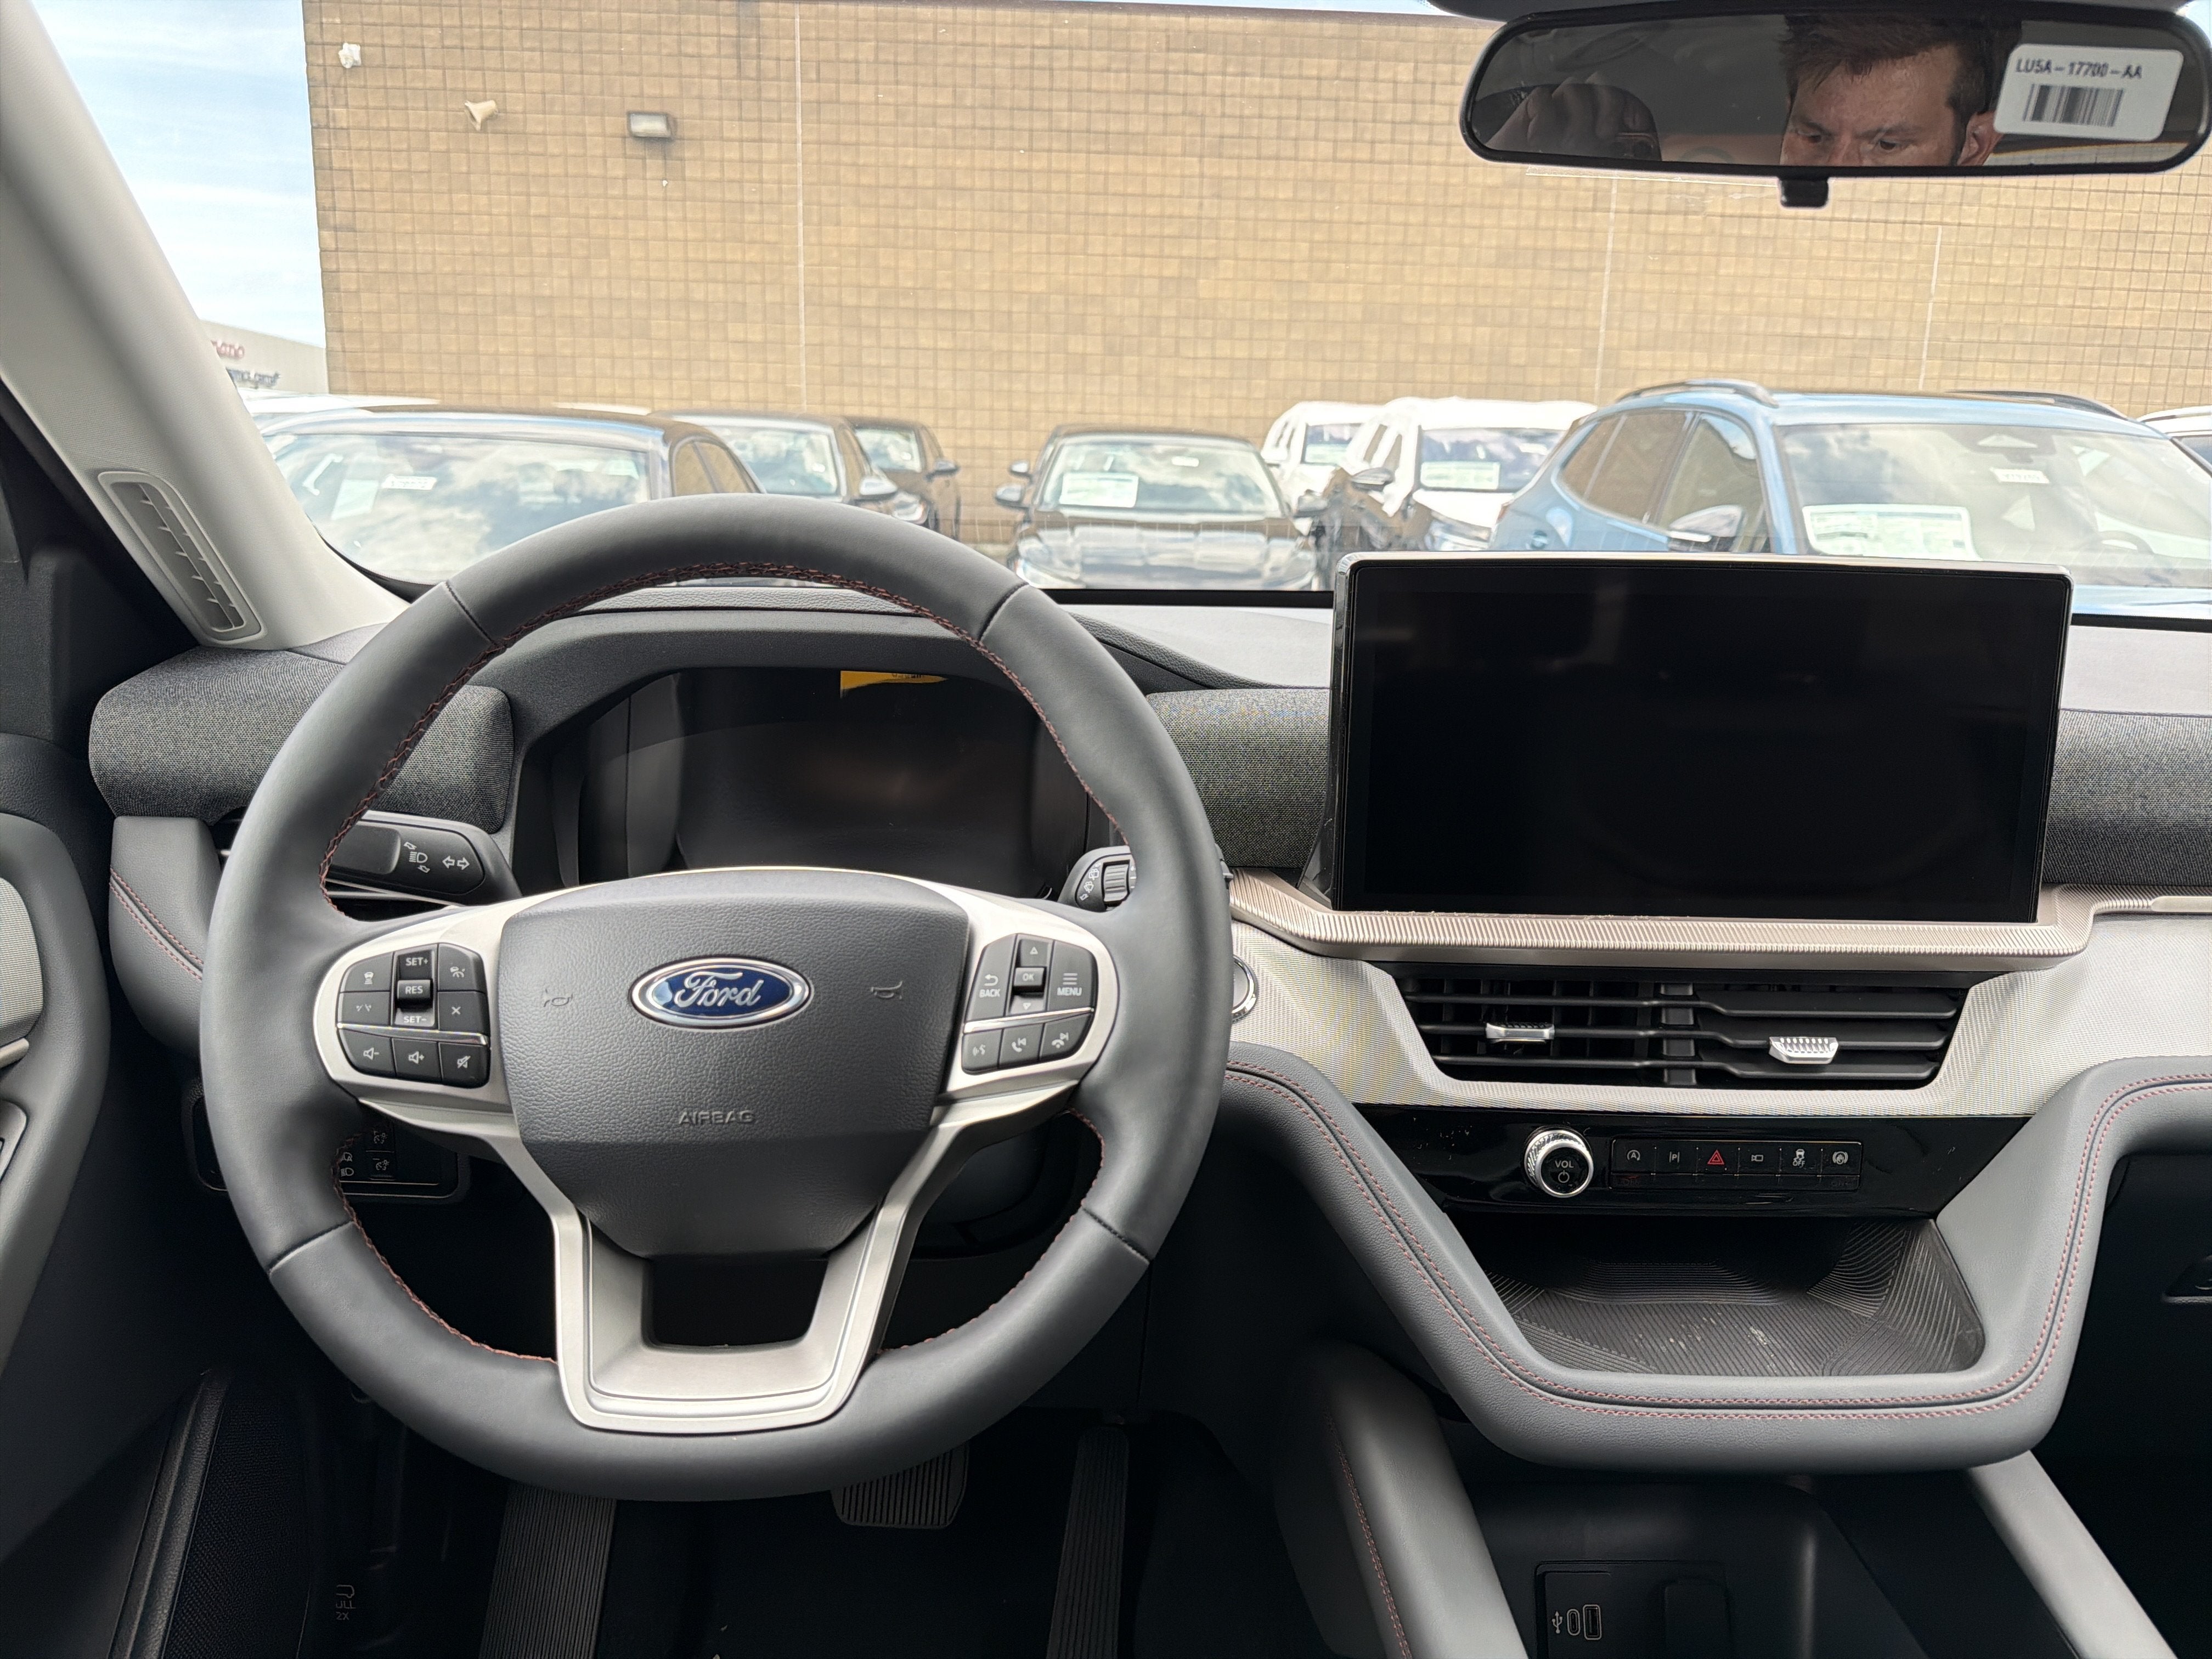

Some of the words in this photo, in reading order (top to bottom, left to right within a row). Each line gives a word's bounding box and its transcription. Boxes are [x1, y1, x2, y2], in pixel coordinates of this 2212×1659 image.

[405, 957, 428, 967] SET+
[1022, 973, 1035, 981] OK
[405, 985, 423, 994] RES
[674, 970, 764, 1008] Ford
[979, 989, 1000, 998] BACK
[1057, 987, 1082, 996] MENU
[679, 1110, 755, 1126] AIRBAG
[1555, 1160, 1574, 1169] VOL
